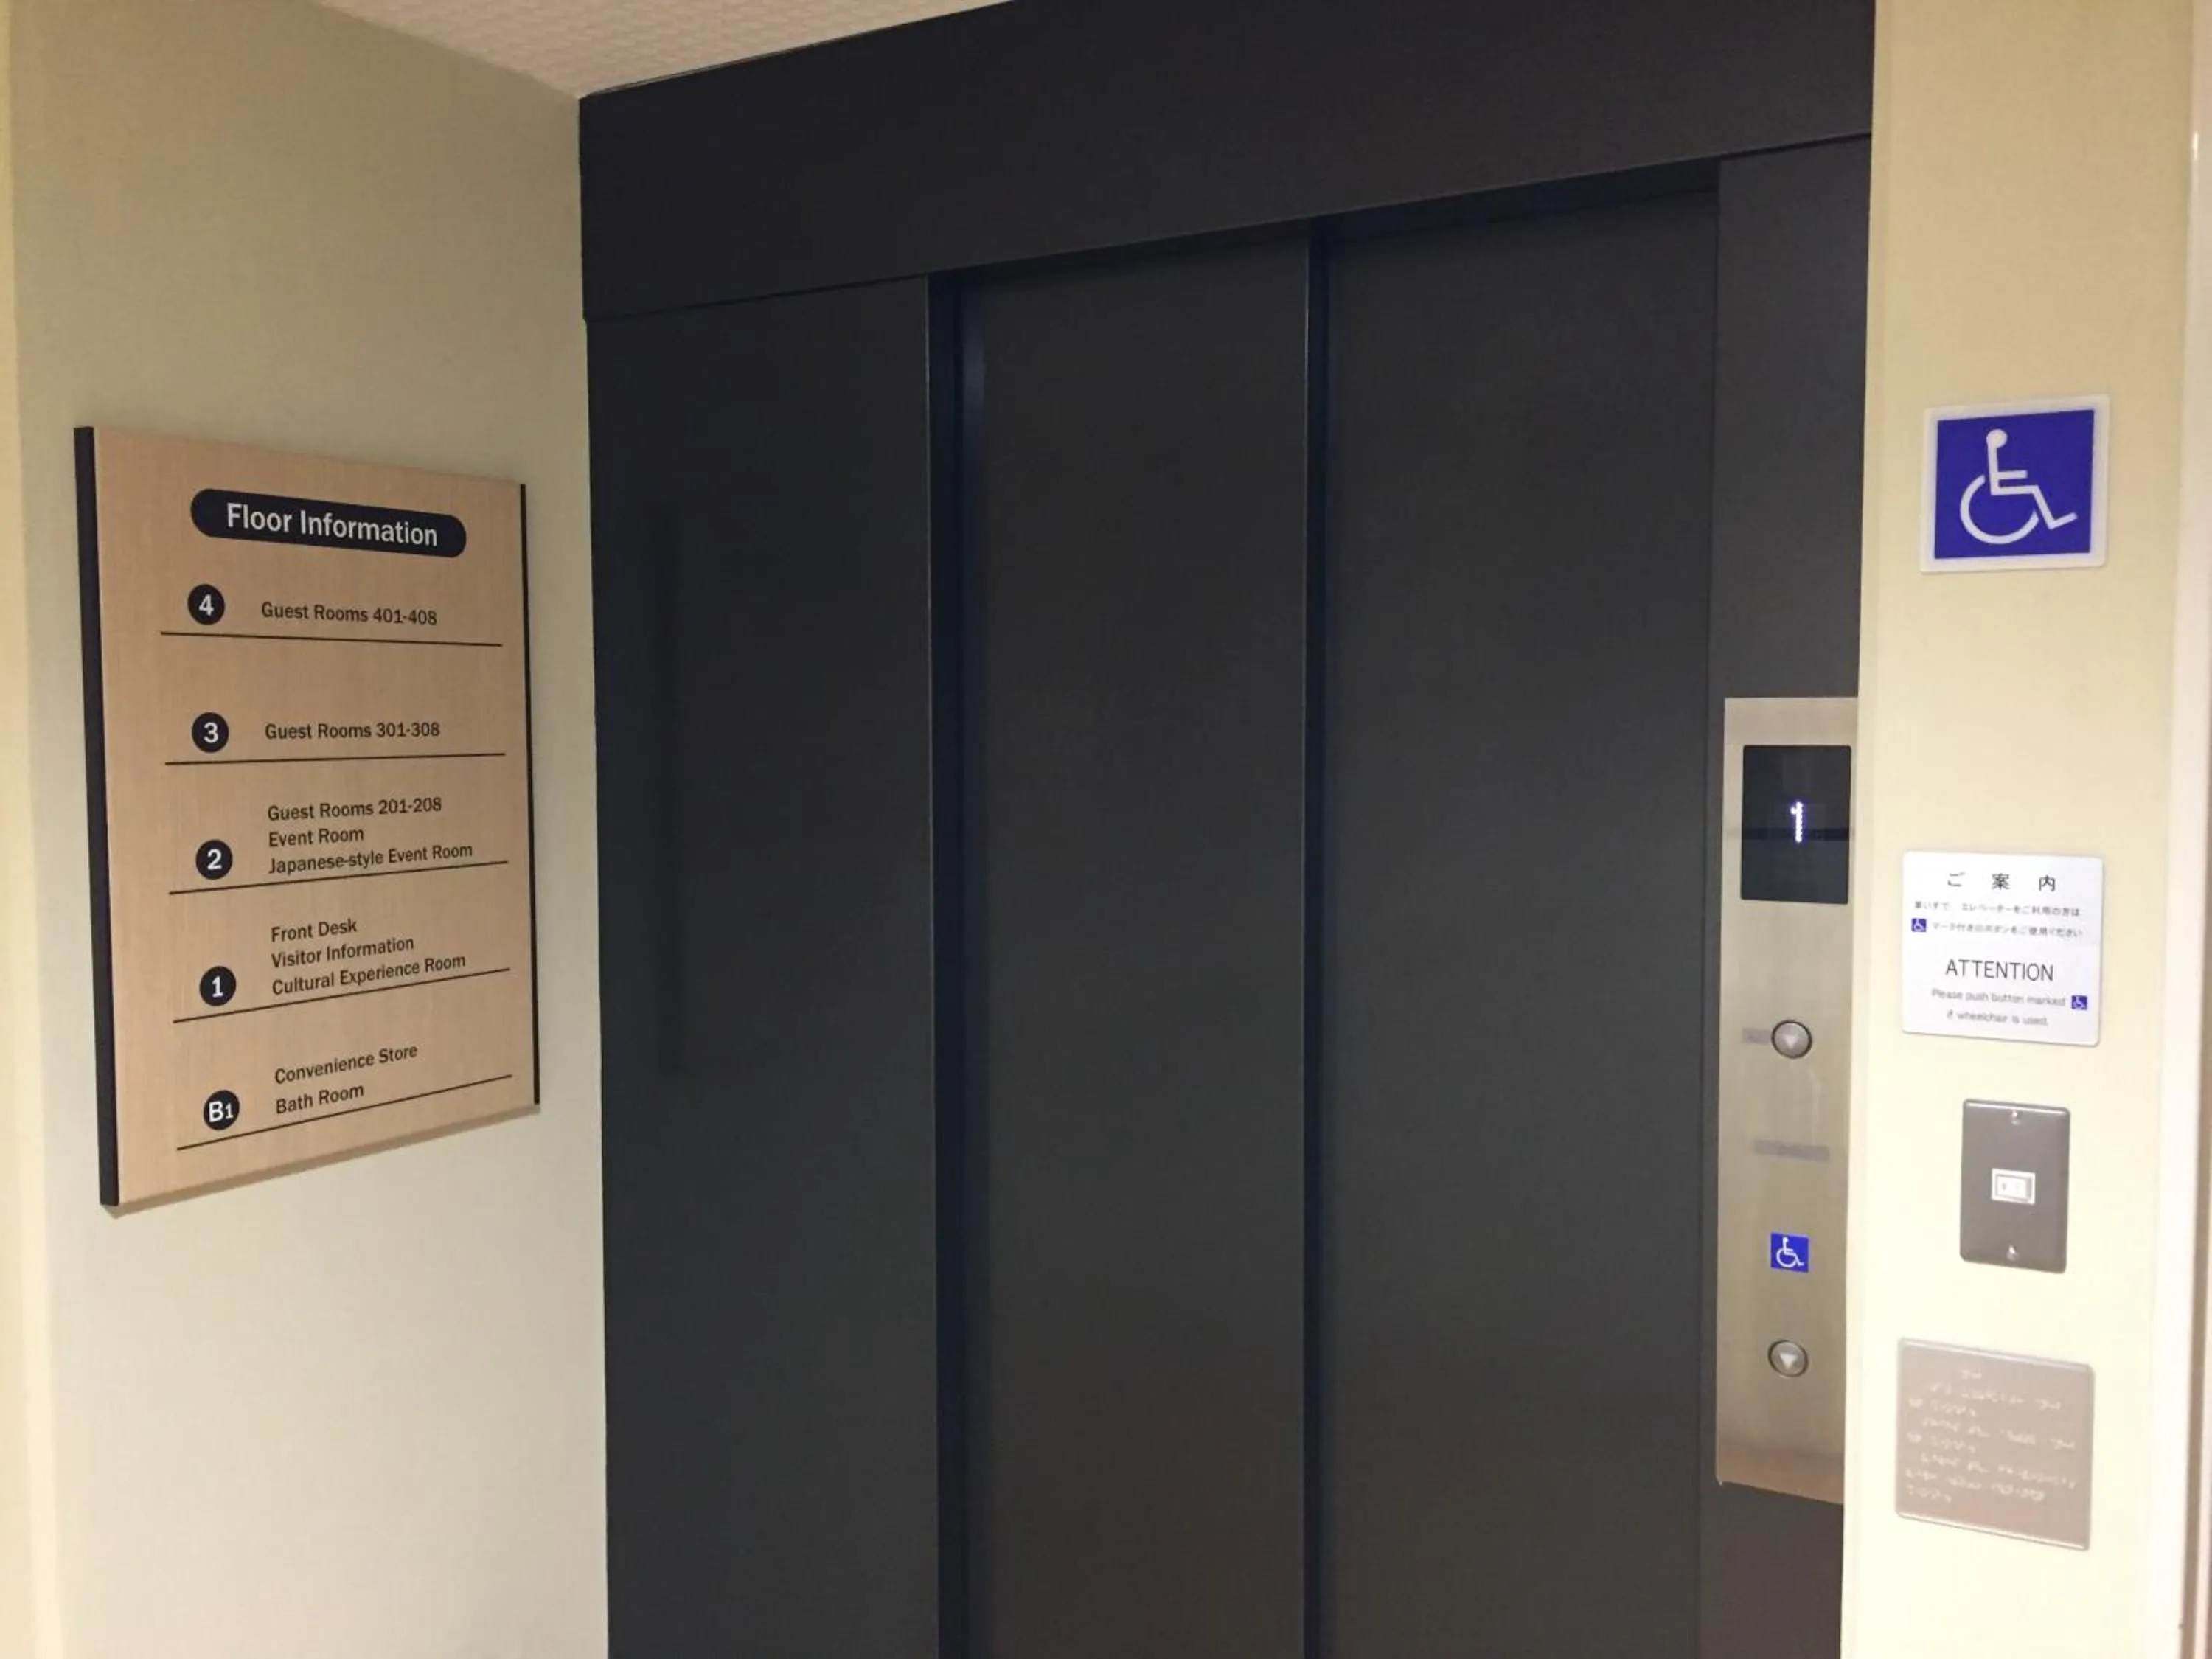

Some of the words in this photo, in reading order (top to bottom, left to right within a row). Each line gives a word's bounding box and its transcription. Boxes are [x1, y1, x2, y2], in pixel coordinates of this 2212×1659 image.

[226, 502, 292, 533] Floor
[300, 510, 437, 546] Information
[198, 594, 215, 616] 4
[262, 601, 309, 620] Guest
[314, 605, 368, 622] Rooms
[373, 608, 437, 625] 401-408
[203, 722, 219, 743] 3
[265, 723, 311, 740] Guest
[318, 723, 372, 738] Rooms
[376, 722, 440, 737] 301-308
[268, 804, 315, 821] Guest
[319, 802, 373, 818] Rooms
[378, 797, 442, 815] 201-208
[1790, 801, 1804, 843] 1
[269, 830, 313, 848] Event
[319, 828, 364, 844] Room
[206, 848, 222, 870] 2
[268, 851, 383, 875] Japanese-style
[389, 847, 428, 864] Event
[432, 844, 473, 860] Room
[1947, 872, 2057, 892] ご案内
[271, 924, 313, 942] Front
[318, 918, 358, 937] Desk
[271, 947, 322, 968] Visitor
[327, 937, 414, 961] Information
[272, 973, 335, 995] Cultural
[340, 958, 420, 985] Experience
[425, 954, 466, 972] Room
[1945, 959, 2053, 982] ATTENTION
[211, 975, 223, 998] 1
[1931, 988, 1963, 1000] Please
[1965, 991, 1989, 1002] push
[1992, 992, 2024, 1004] button
[2027, 995, 2066, 1007] marked
[1958, 1012, 2008, 1023] wheelchair
[275, 1053, 375, 1085] Convenience
[379, 1044, 418, 1063] Store
[276, 1093, 313, 1114] Bath
[319, 1085, 364, 1105] Room
[208, 1101, 234, 1123] B1
